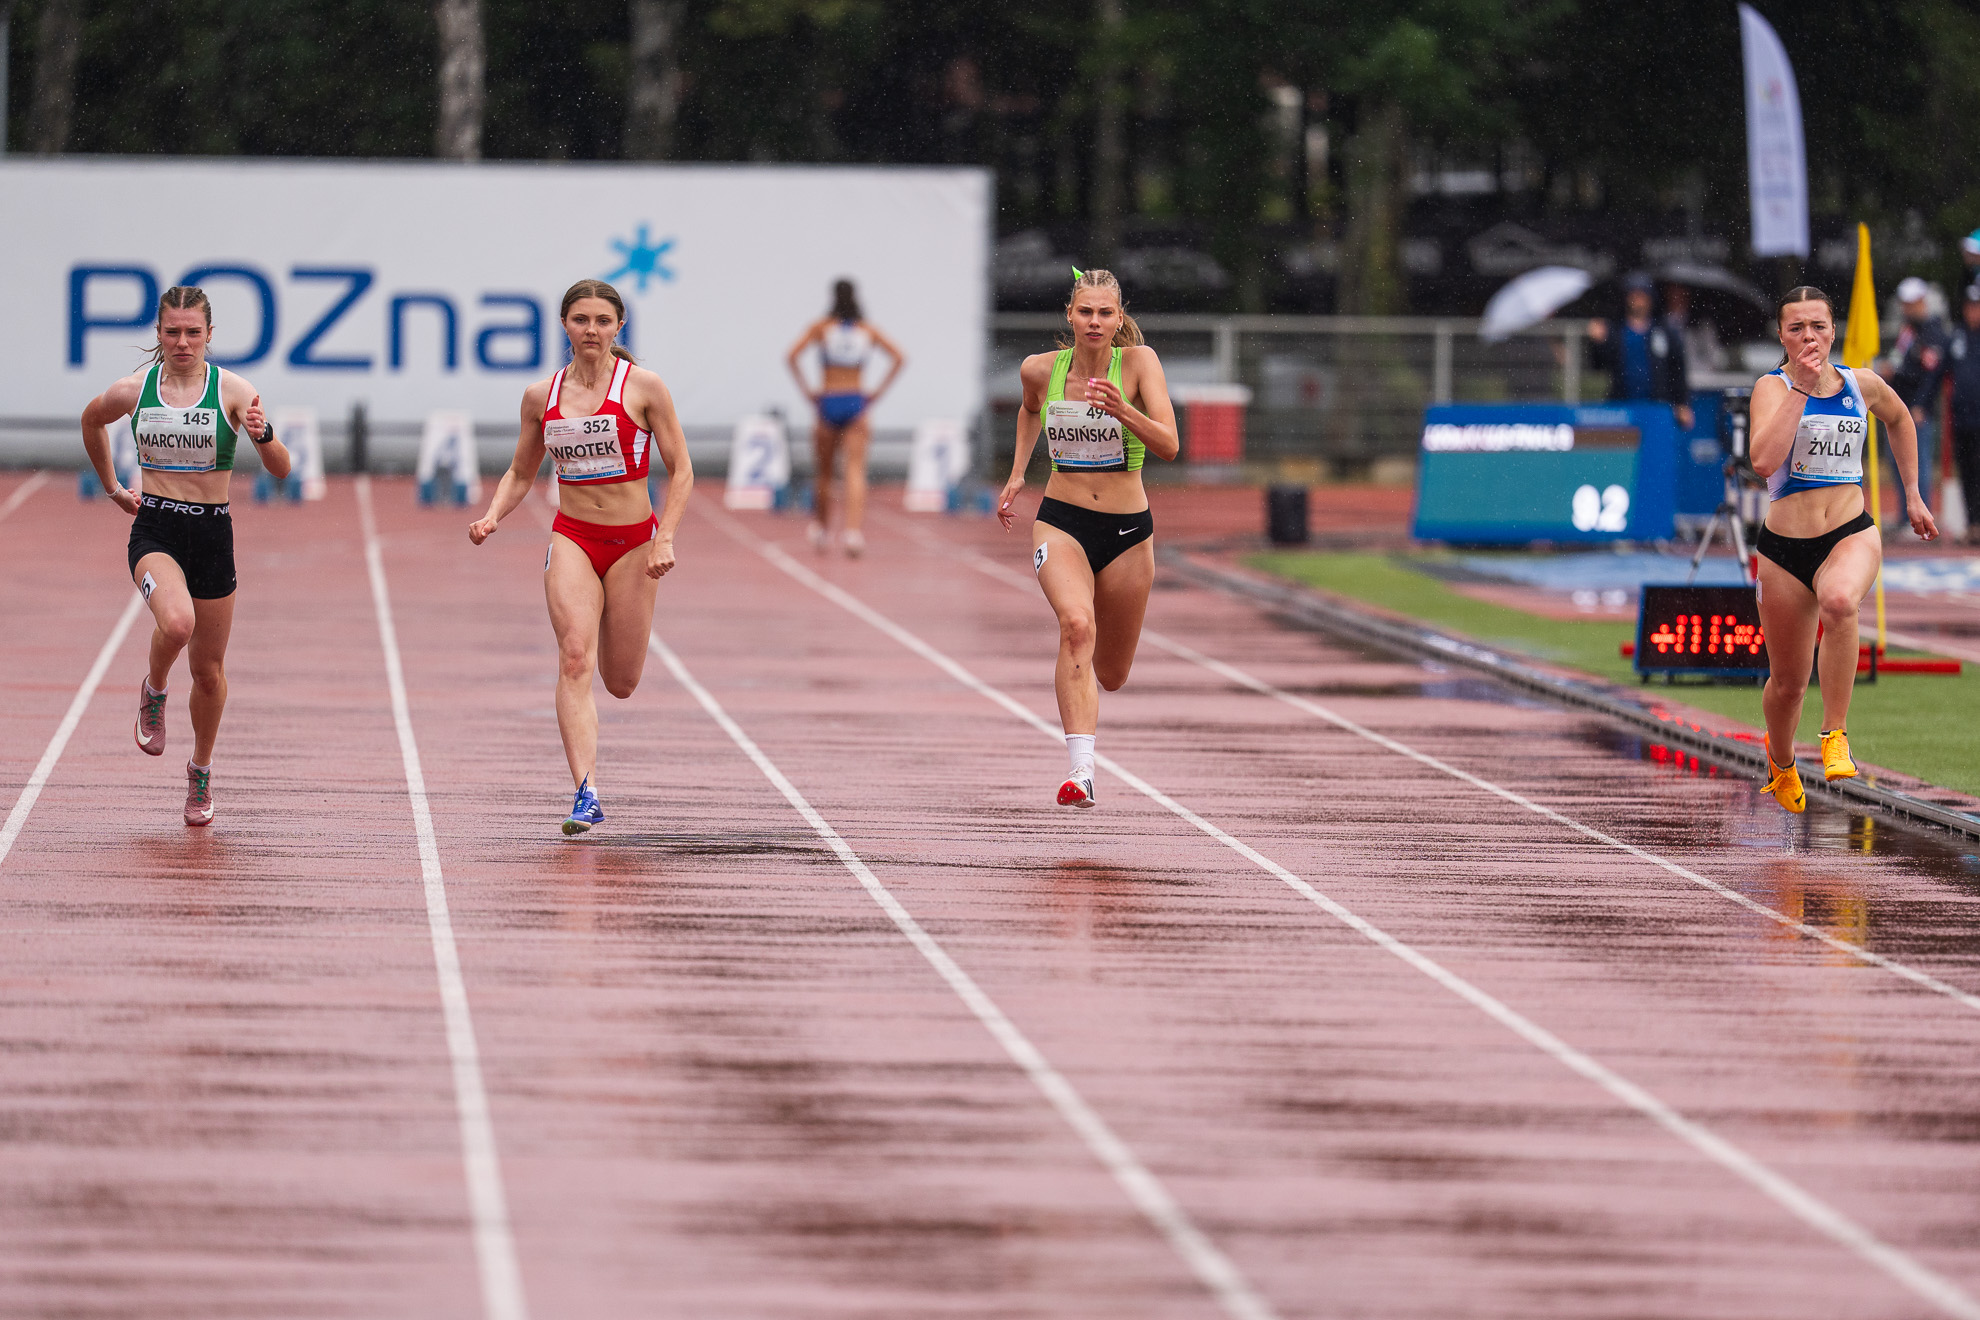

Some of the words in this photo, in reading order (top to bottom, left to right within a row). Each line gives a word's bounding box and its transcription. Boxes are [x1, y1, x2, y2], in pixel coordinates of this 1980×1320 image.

[182, 412, 210, 426] 145
[583, 419, 611, 434] 352
[1837, 420, 1861, 434] 632
[139, 433, 214, 449] MARCYNIUK
[1047, 425, 1120, 442] BASIŃSKA
[549, 440, 618, 460] WROTEK
[1807, 437, 1851, 457] ŻYLLA
[160, 501, 205, 516] PRO
[1034, 548, 1044, 569] 3
